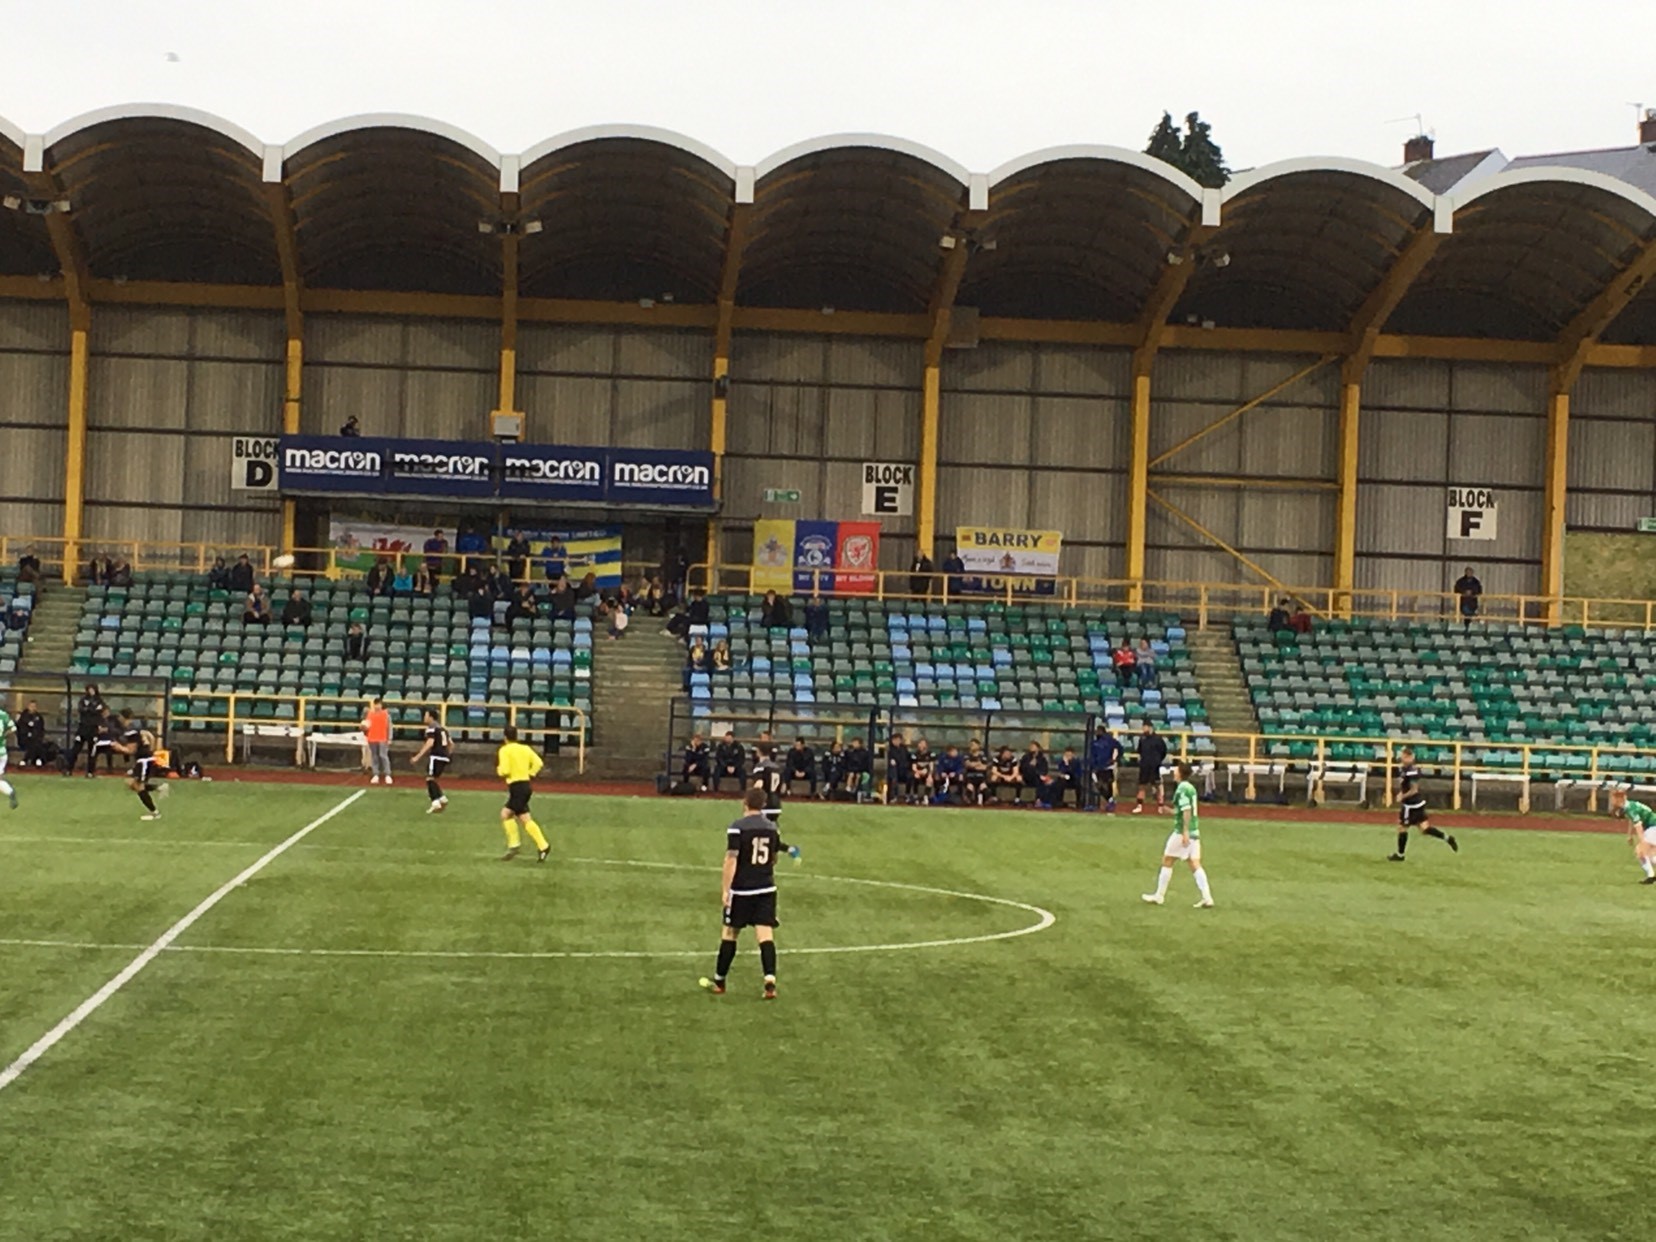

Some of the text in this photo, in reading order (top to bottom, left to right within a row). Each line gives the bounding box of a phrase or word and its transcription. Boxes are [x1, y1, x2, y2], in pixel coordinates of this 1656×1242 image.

[285, 448, 381, 469] macron
[246, 460, 273, 487] D
[614, 462, 709, 484] macron
[865, 465, 912, 485] BLOCK
[875, 486, 899, 513] E
[1449, 489, 1495, 509] BLOCK
[1460, 510, 1483, 537] F
[974, 531, 1042, 549] BARRY
[751, 836, 770, 865] 15
